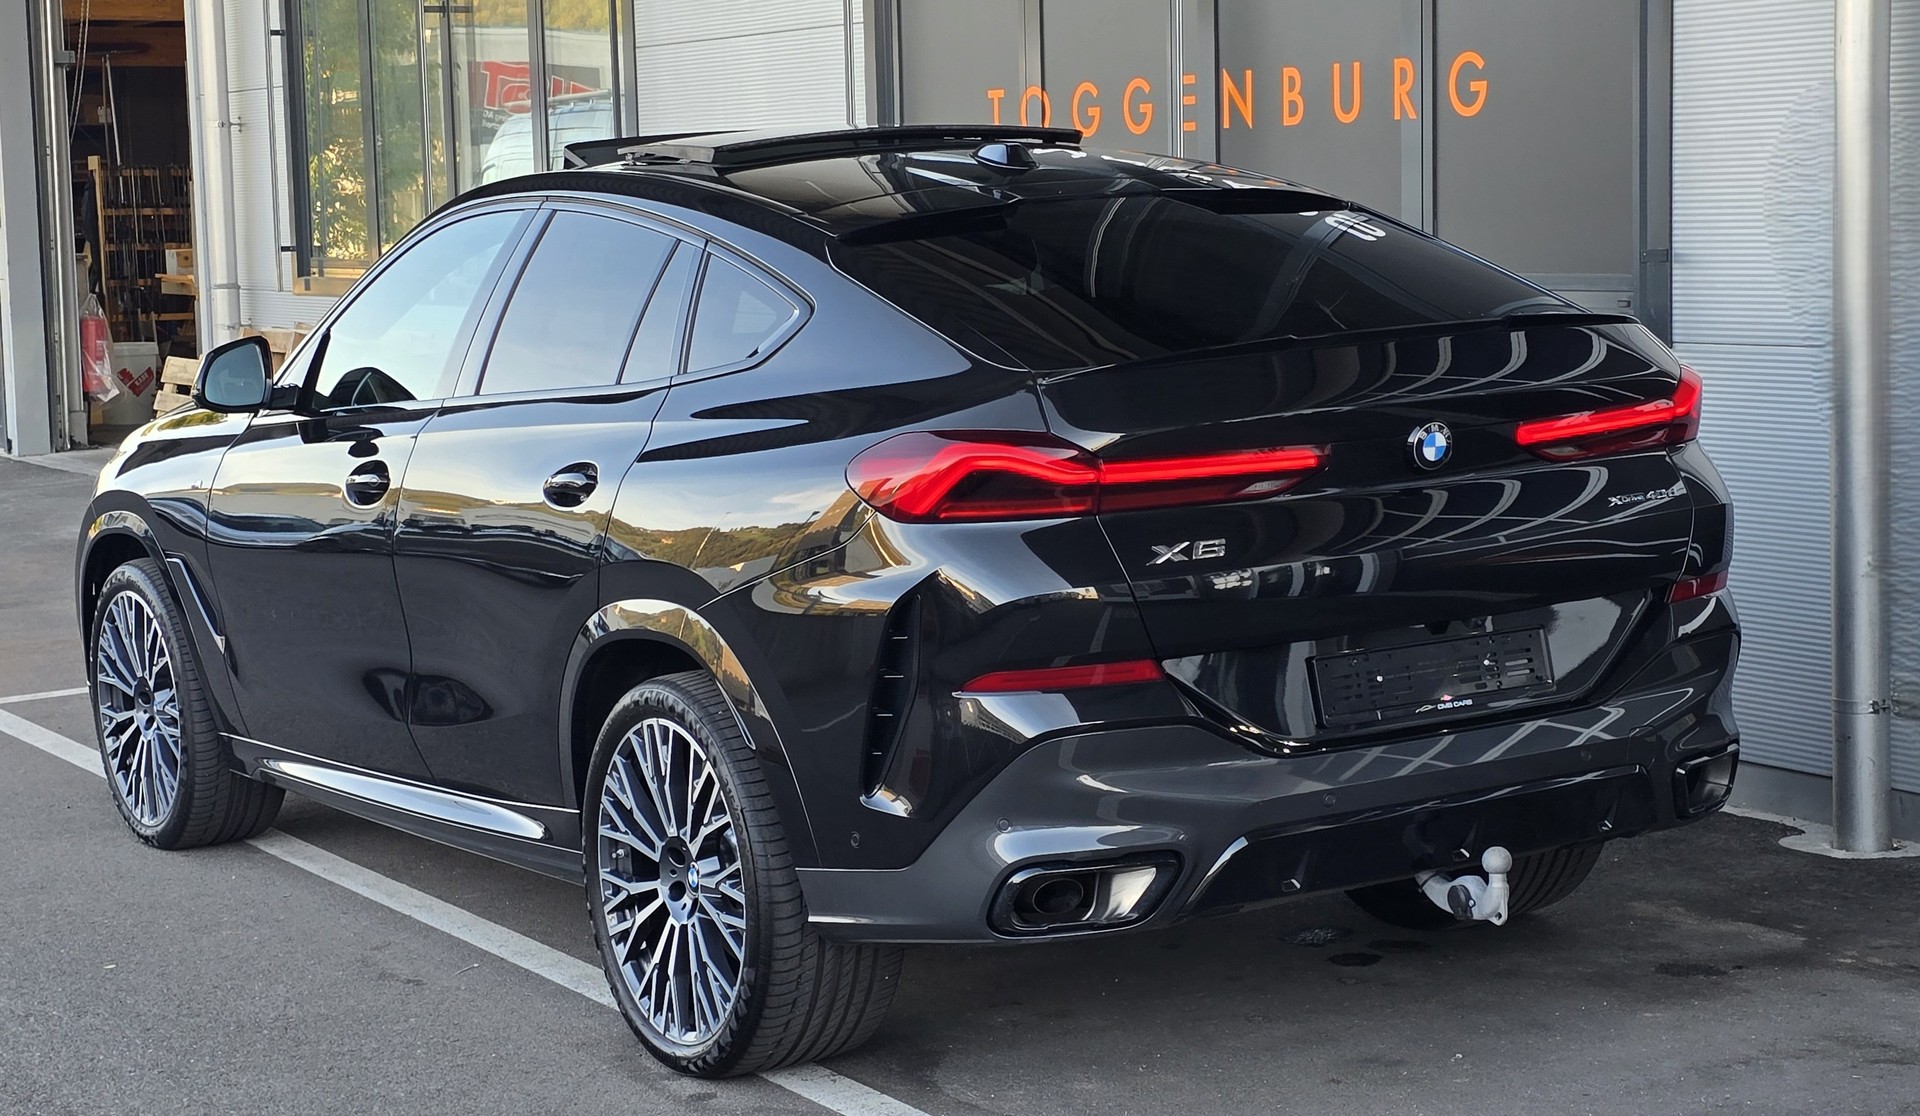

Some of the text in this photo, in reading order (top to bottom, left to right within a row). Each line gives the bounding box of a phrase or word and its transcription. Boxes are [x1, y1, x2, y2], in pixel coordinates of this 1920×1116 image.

[987, 51, 1489, 138] TOGGENBURG
[1419, 424, 1452, 447] BMW
[1146, 539, 1226, 566] X6
